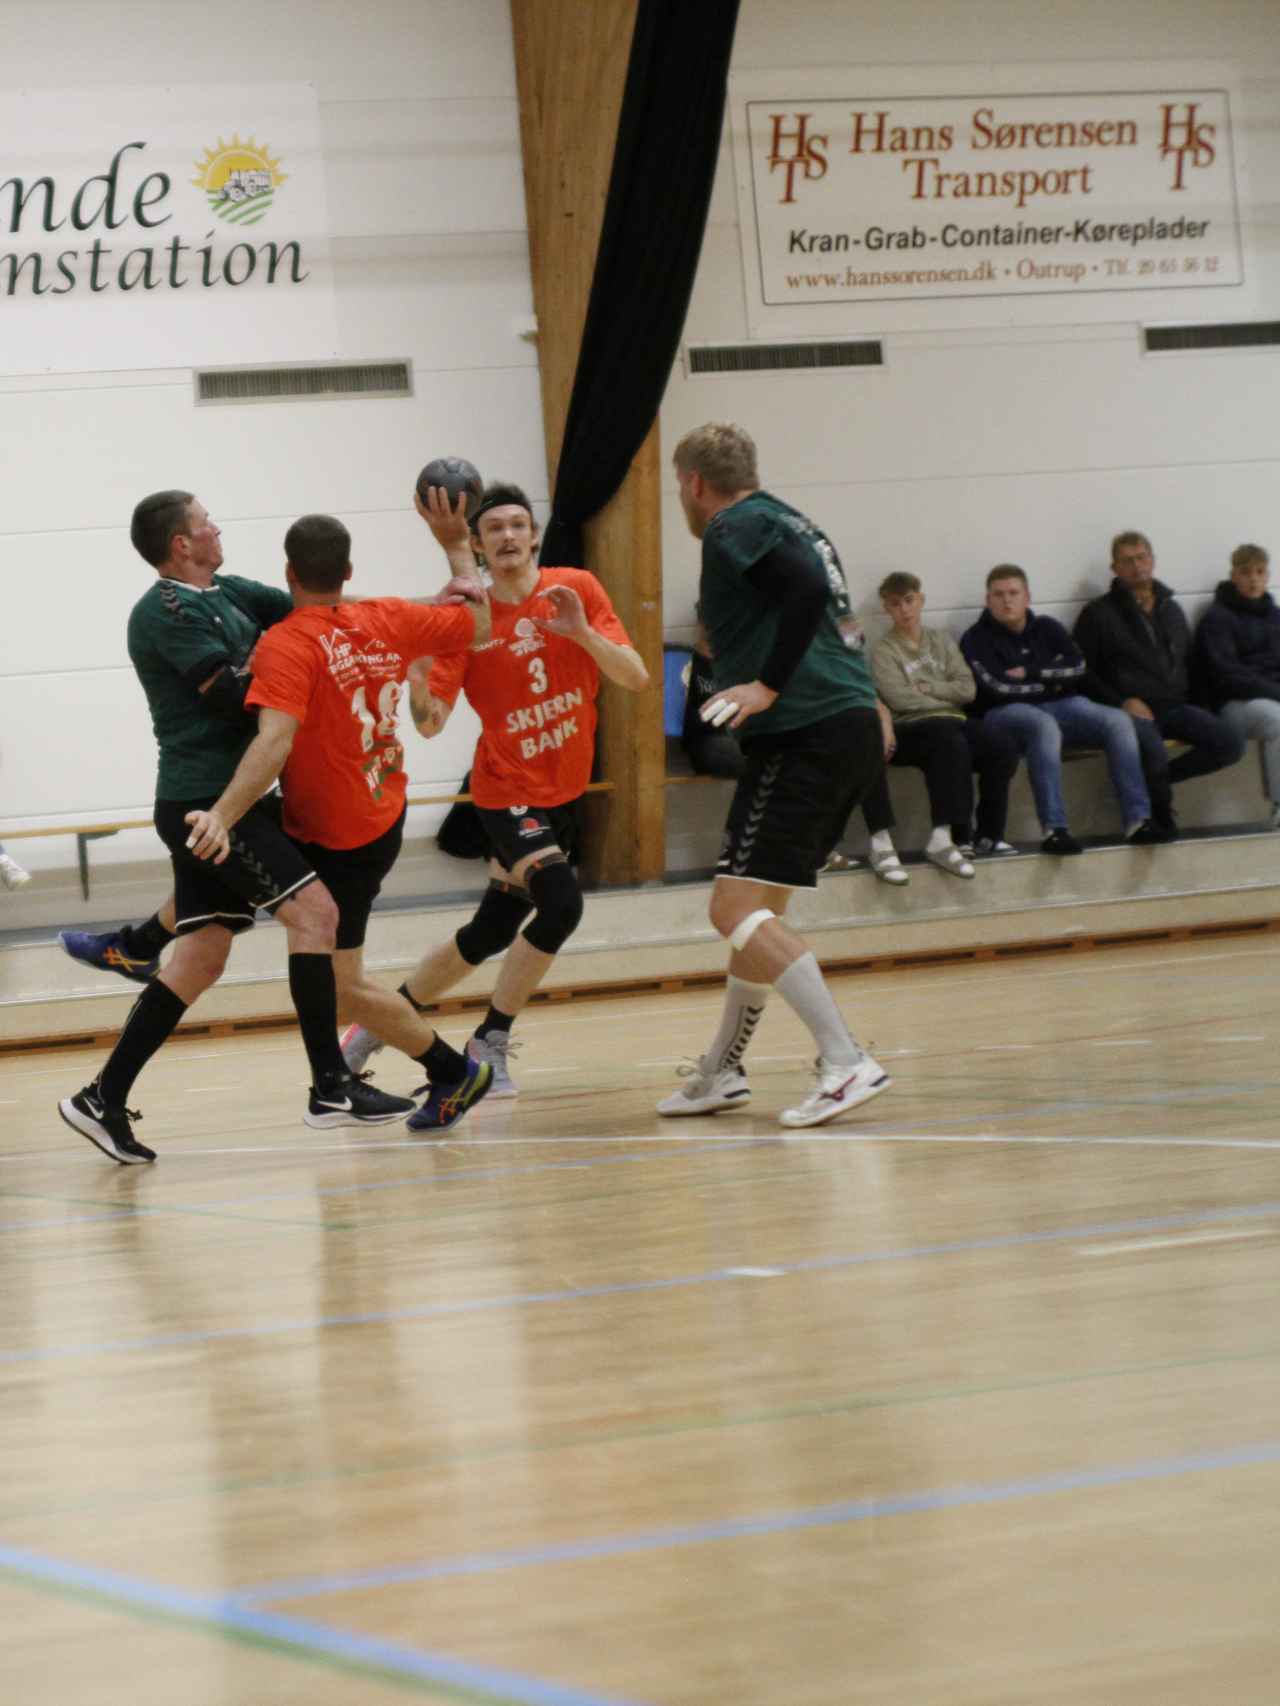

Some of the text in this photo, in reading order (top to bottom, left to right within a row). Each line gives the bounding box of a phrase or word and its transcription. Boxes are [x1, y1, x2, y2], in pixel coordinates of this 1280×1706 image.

[849, 107, 1138, 154] Hans Sørensen
[902, 158, 1094, 208] Transport
[1016, 257, 1087, 283] Outrup
[528, 657, 548, 693] 3
[506, 688, 582, 733] SKJERN
[521, 717, 578, 759] BANK
